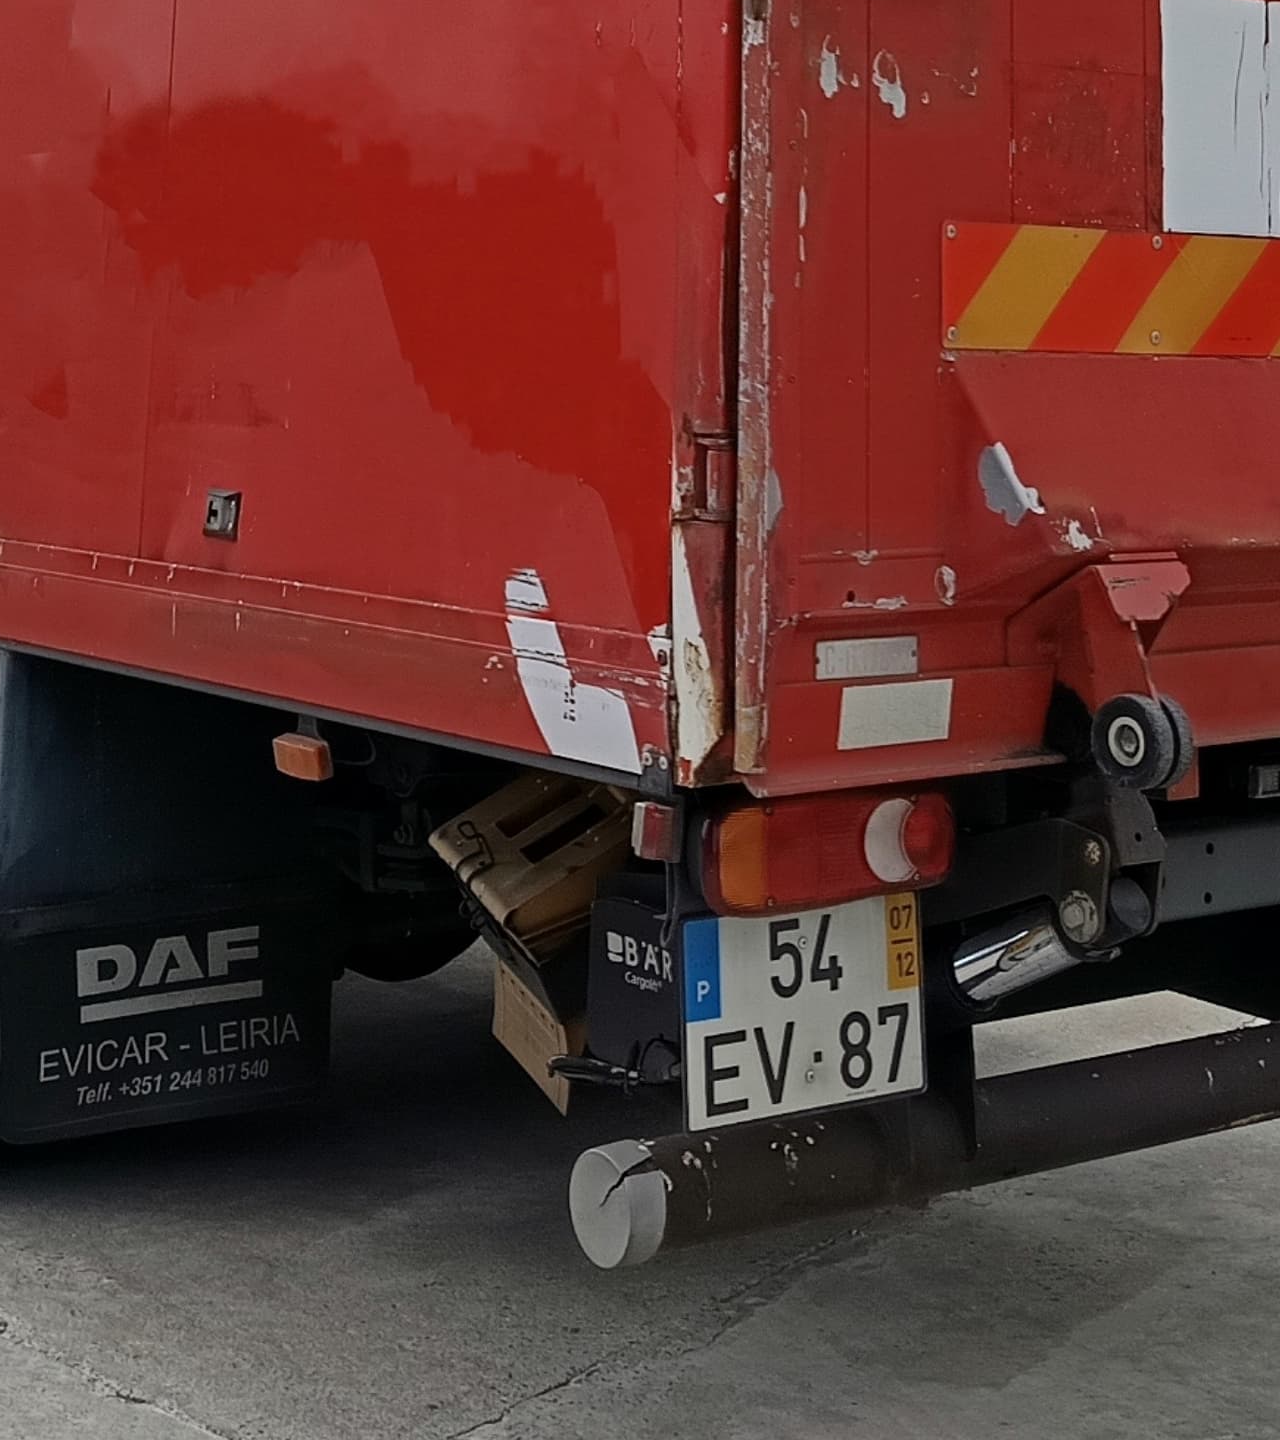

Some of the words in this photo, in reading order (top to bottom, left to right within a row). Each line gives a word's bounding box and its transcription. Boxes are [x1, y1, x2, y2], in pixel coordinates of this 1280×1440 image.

[890, 904, 913, 930] 07
[76, 925, 260, 998] DAF
[769, 914, 843, 998] 54
[896, 952, 916, 978] 12
[697, 980, 710, 1002] P
[39, 1031, 169, 1083] EVICAR
[200, 1013, 301, 1056] LEIRIA
[76, 1081, 113, 1106] Telf.
[118, 1074, 163, 1097] +351
[168, 1068, 202, 1092] 244
[207, 1063, 237, 1087] 817
[240, 1058, 270, 1081] 540
